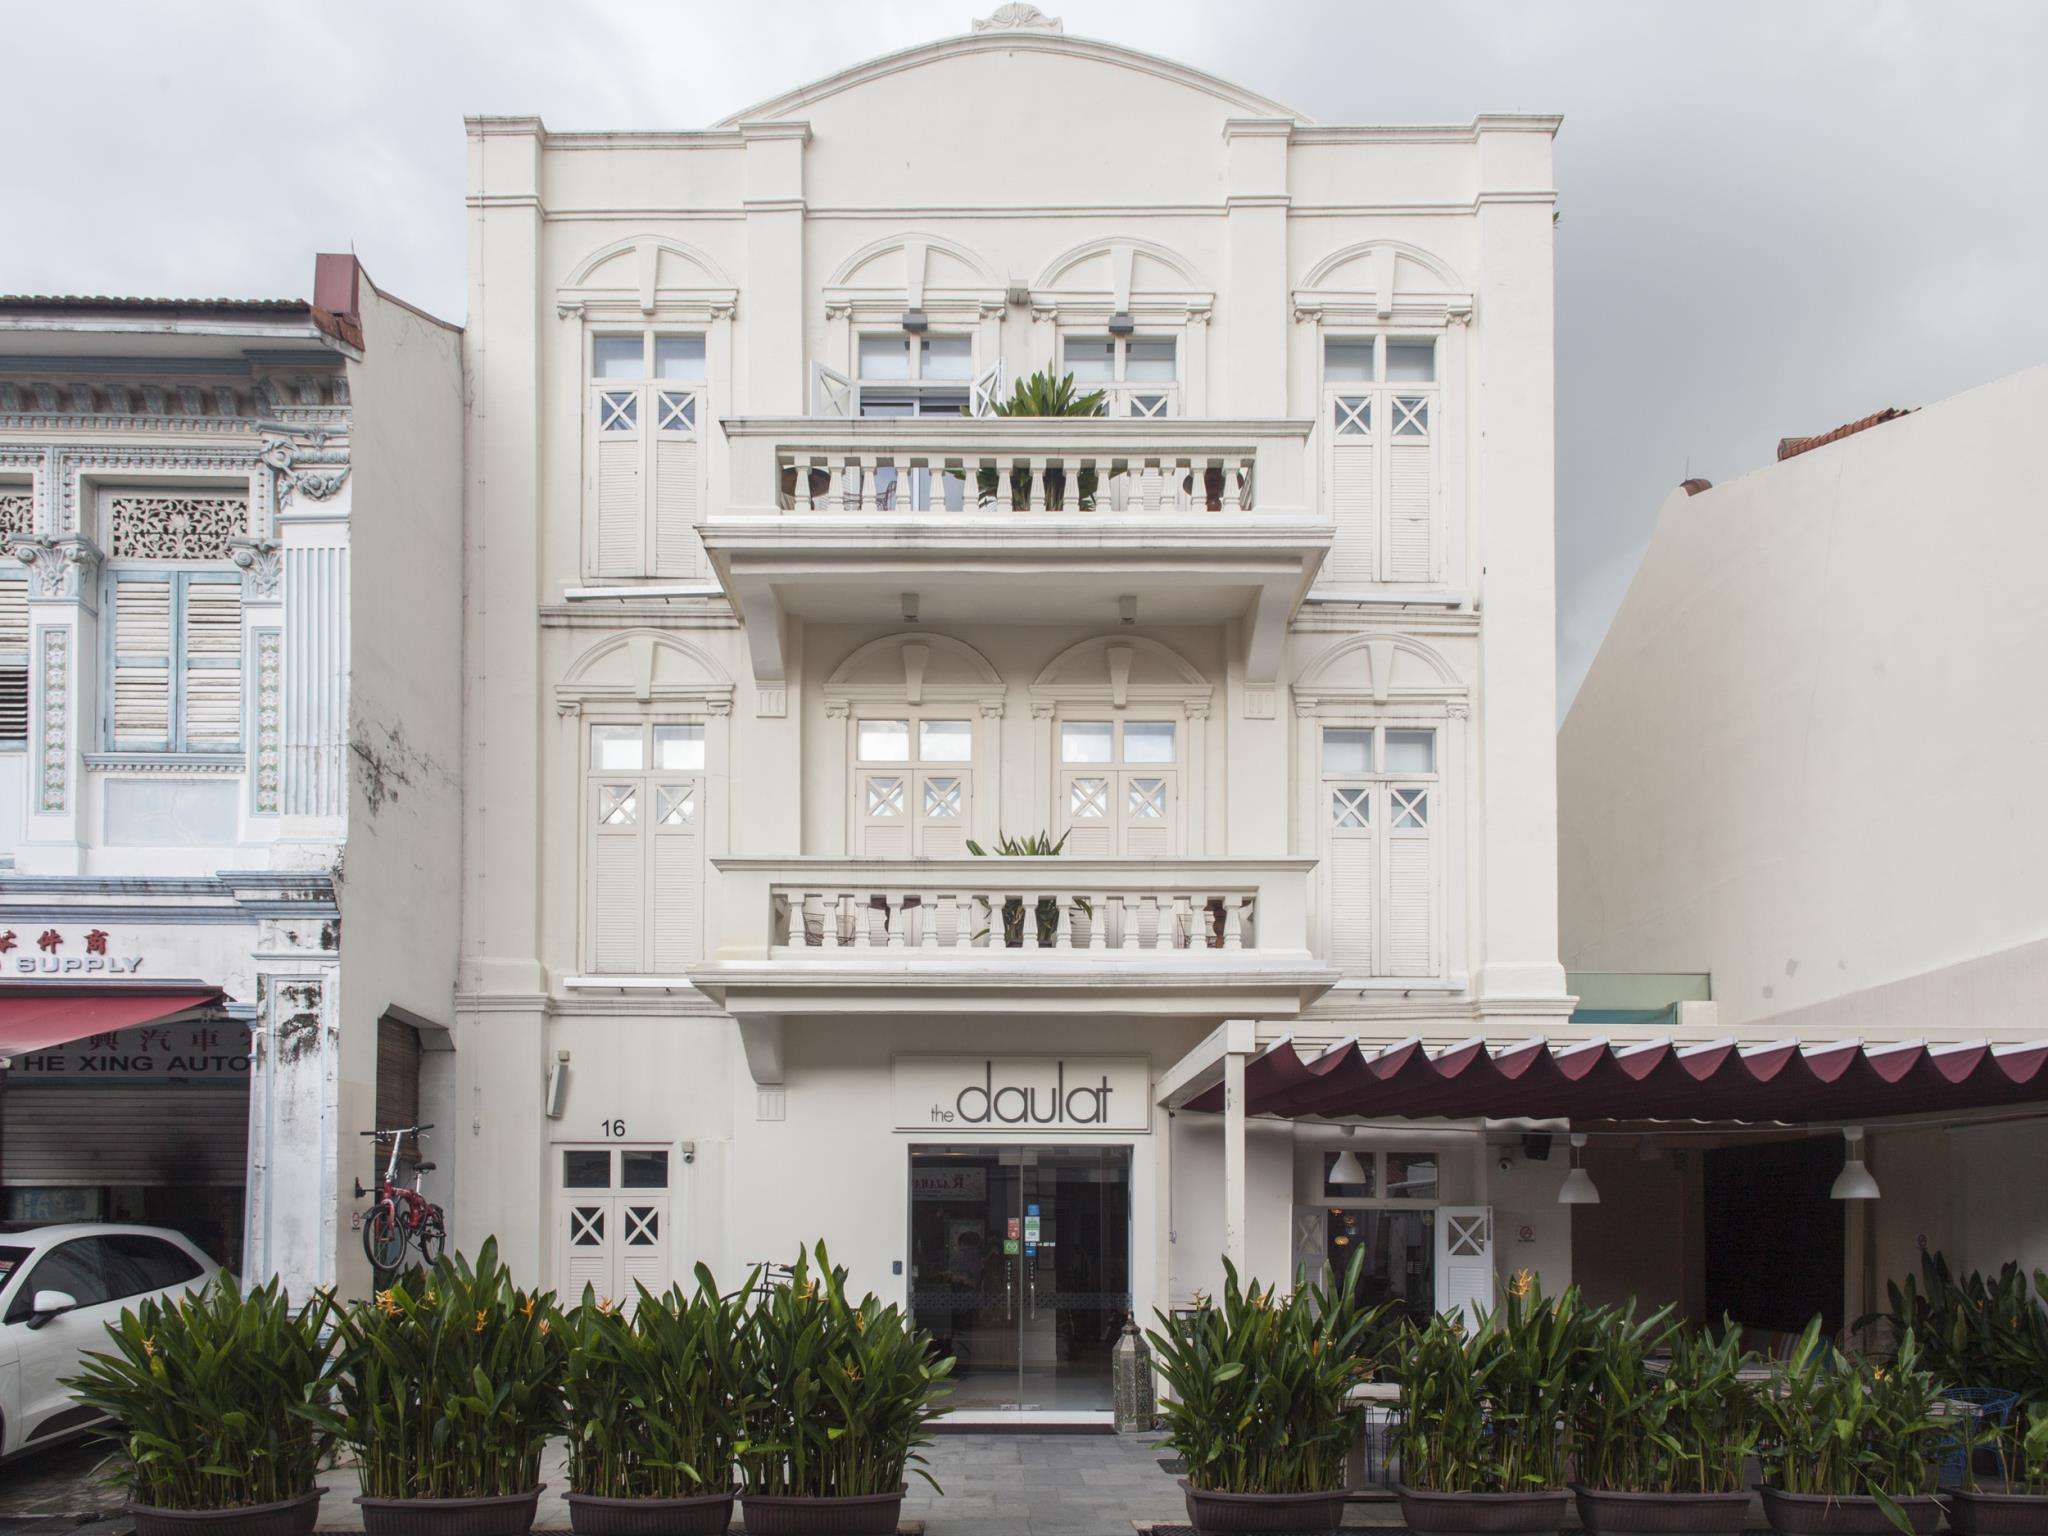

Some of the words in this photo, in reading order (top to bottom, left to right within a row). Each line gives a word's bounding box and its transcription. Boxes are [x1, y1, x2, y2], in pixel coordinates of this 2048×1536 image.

[16, 957, 143, 973] SUPPLY
[78, 1055, 153, 1072] XING
[166, 1055, 249, 1072] AUTO
[931, 1104, 955, 1123] the
[956, 1061, 1113, 1123] daulat
[601, 1119, 626, 1137] 16
